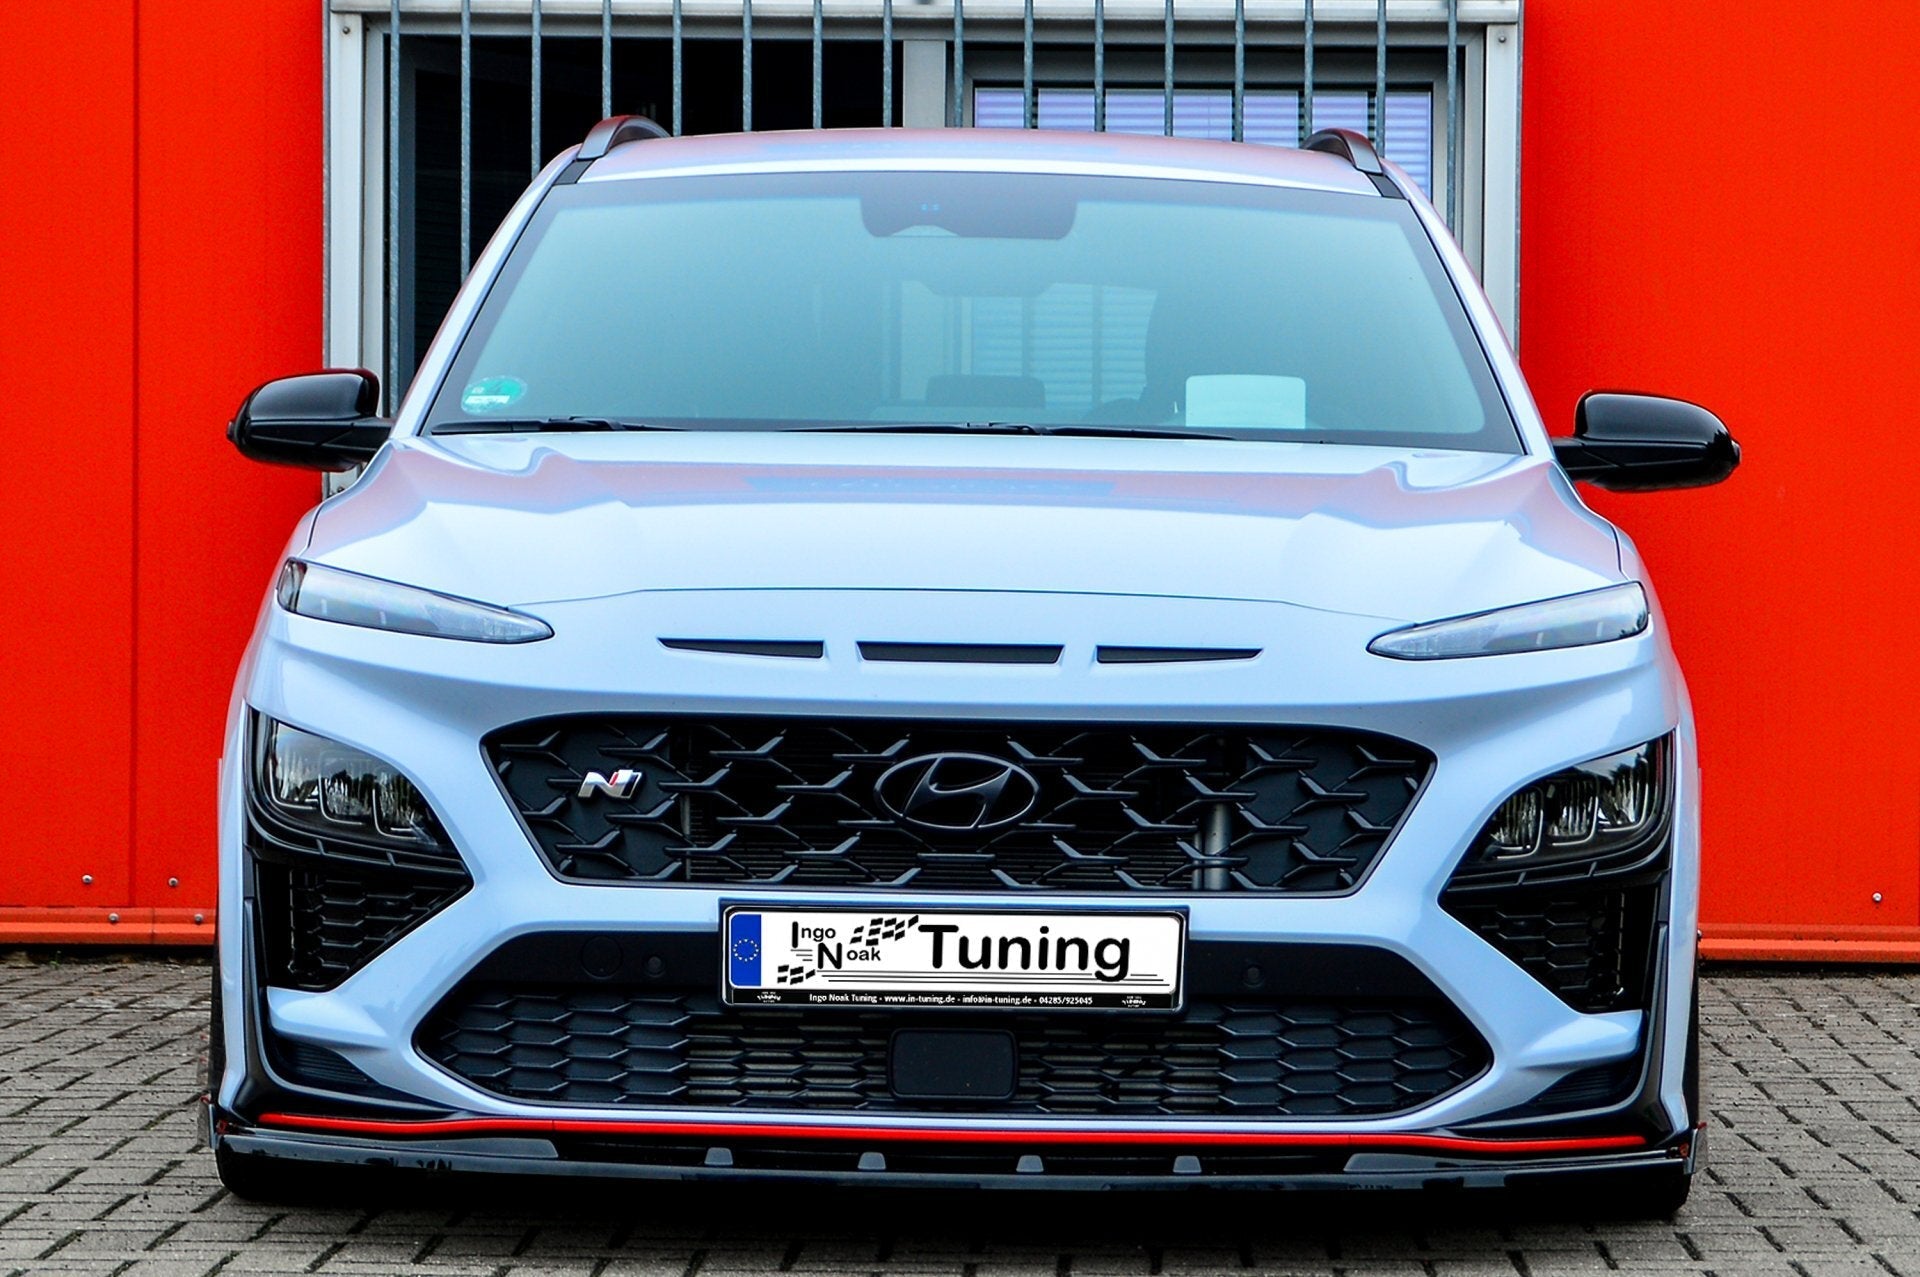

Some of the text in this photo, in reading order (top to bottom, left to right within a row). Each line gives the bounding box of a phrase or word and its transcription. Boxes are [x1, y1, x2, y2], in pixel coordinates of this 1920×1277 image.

[792, 921, 836, 949] Ingo
[818, 942, 881, 970] Noak
[918, 924, 1130, 982] Tuning
[809, 993, 827, 1004] Ingo
[828, 993, 850, 1002] Noak
[851, 993, 878, 1004] Tuning
[884, 994, 956, 1005] www.in-tuning.de
